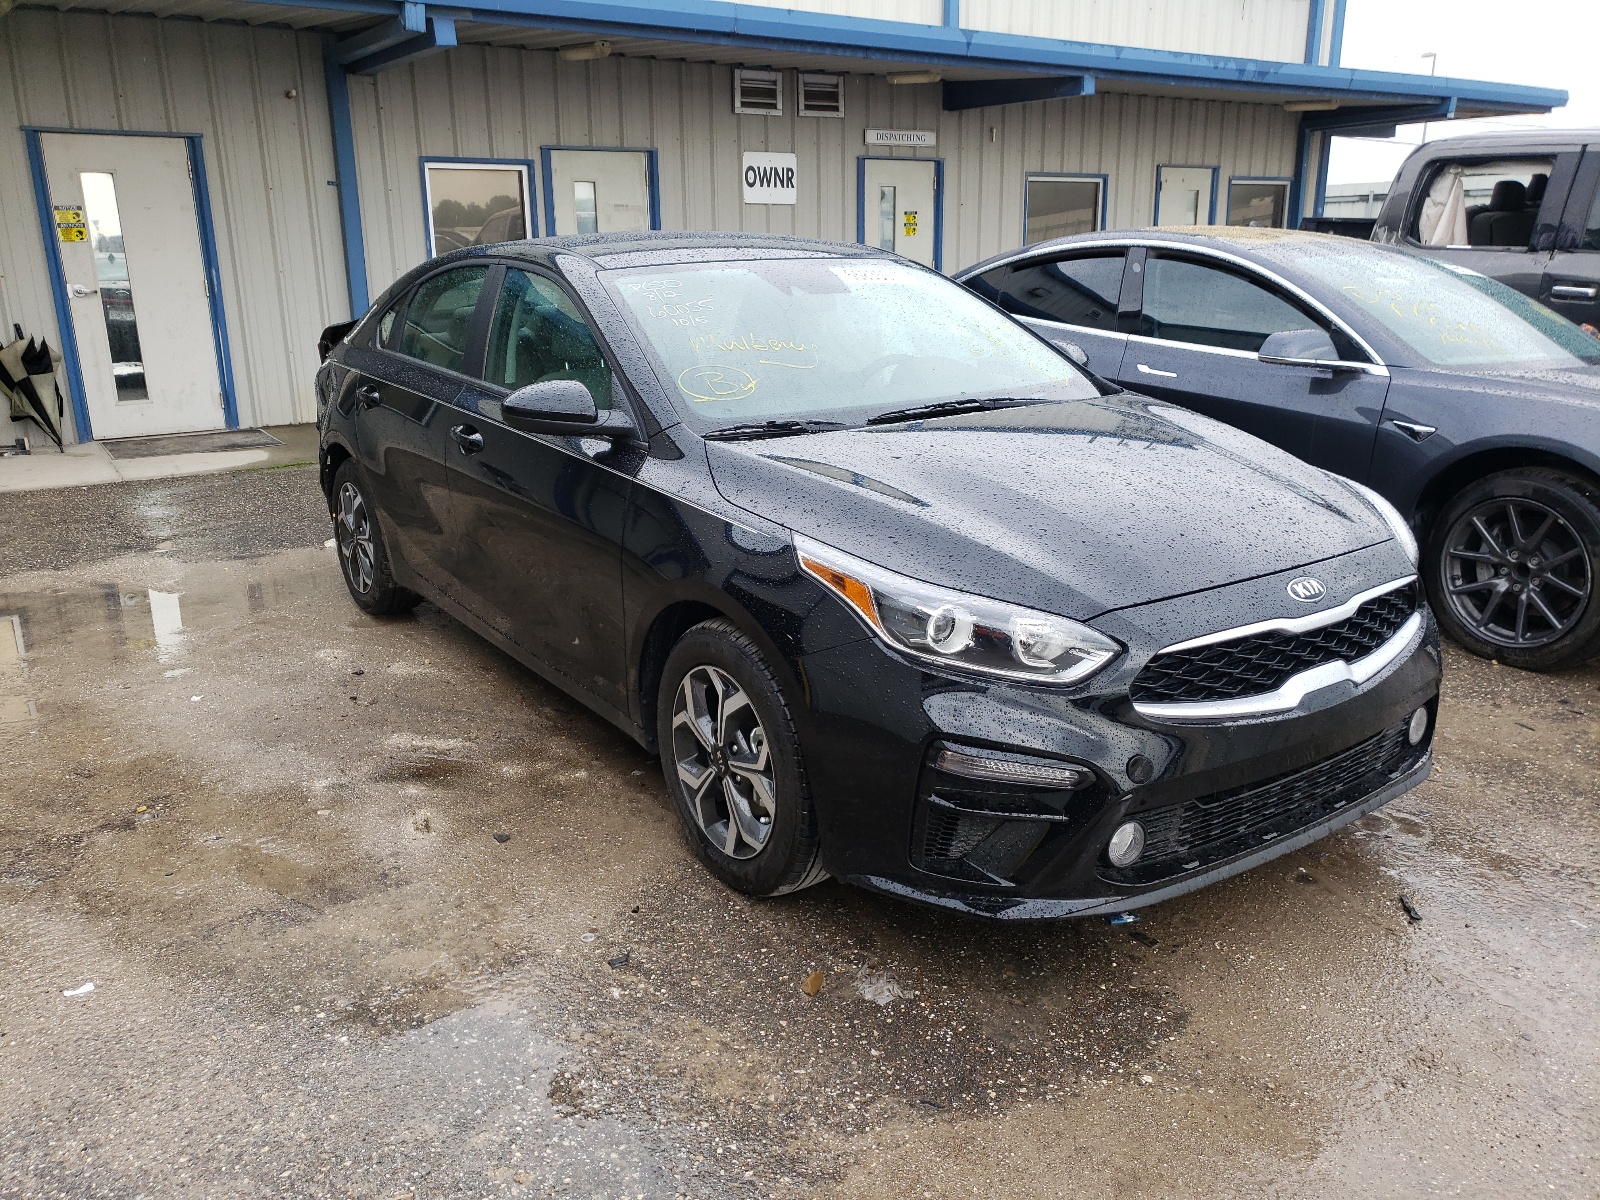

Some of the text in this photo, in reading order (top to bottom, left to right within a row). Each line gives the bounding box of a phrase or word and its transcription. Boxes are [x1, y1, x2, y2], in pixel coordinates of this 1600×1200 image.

[876, 132, 926, 142] DISPATCHING
[745, 165, 795, 188] OWNR
[1292, 579, 1324, 598] KIA
